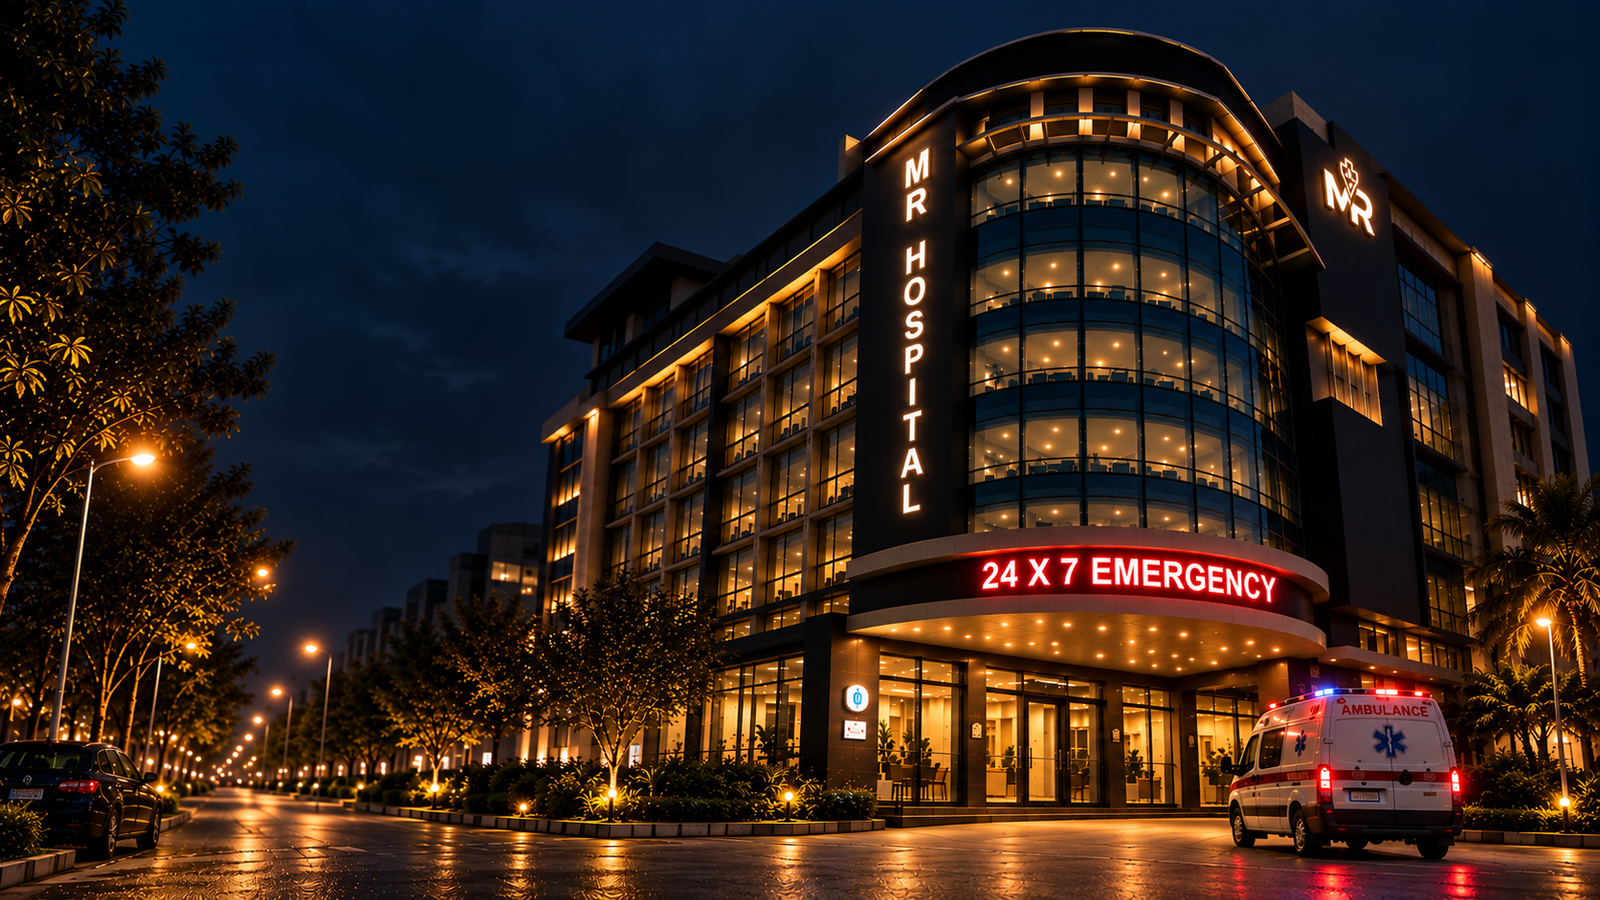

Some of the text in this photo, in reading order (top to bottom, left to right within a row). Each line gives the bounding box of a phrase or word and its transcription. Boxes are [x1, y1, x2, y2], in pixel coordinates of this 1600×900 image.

[900, 147, 931, 515] MR HOSPITAL
[982, 556, 1277, 603] 24 X 7 EMERGENCY
[1341, 703, 1430, 718] AMBULANCE
